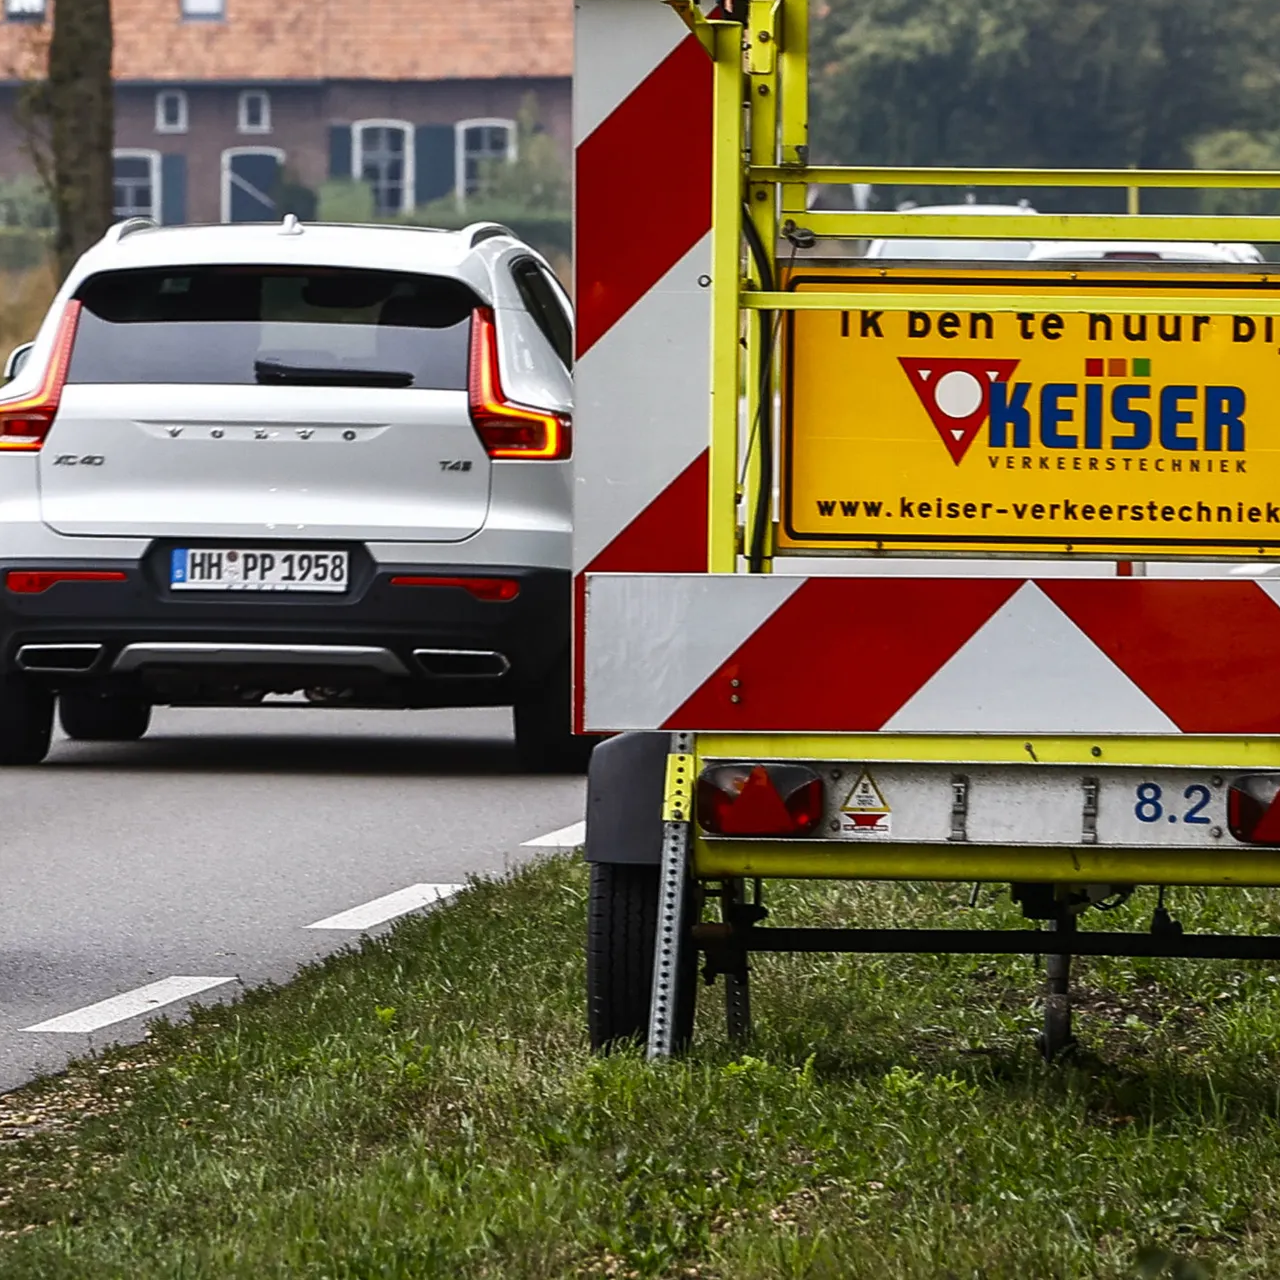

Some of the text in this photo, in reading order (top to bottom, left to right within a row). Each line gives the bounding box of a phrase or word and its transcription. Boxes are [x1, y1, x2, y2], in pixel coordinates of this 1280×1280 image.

[908, 310, 994, 339] ben
[1017, 312, 1065, 340] te
[988, 382, 1246, 452] KEISER
[166, 425, 357, 441] VOLVO
[988, 455, 1248, 474] VERKEERSTECHNIEK
[190, 552, 345, 582] HH PP 1958
[1133, 781, 1212, 825] 8.2
